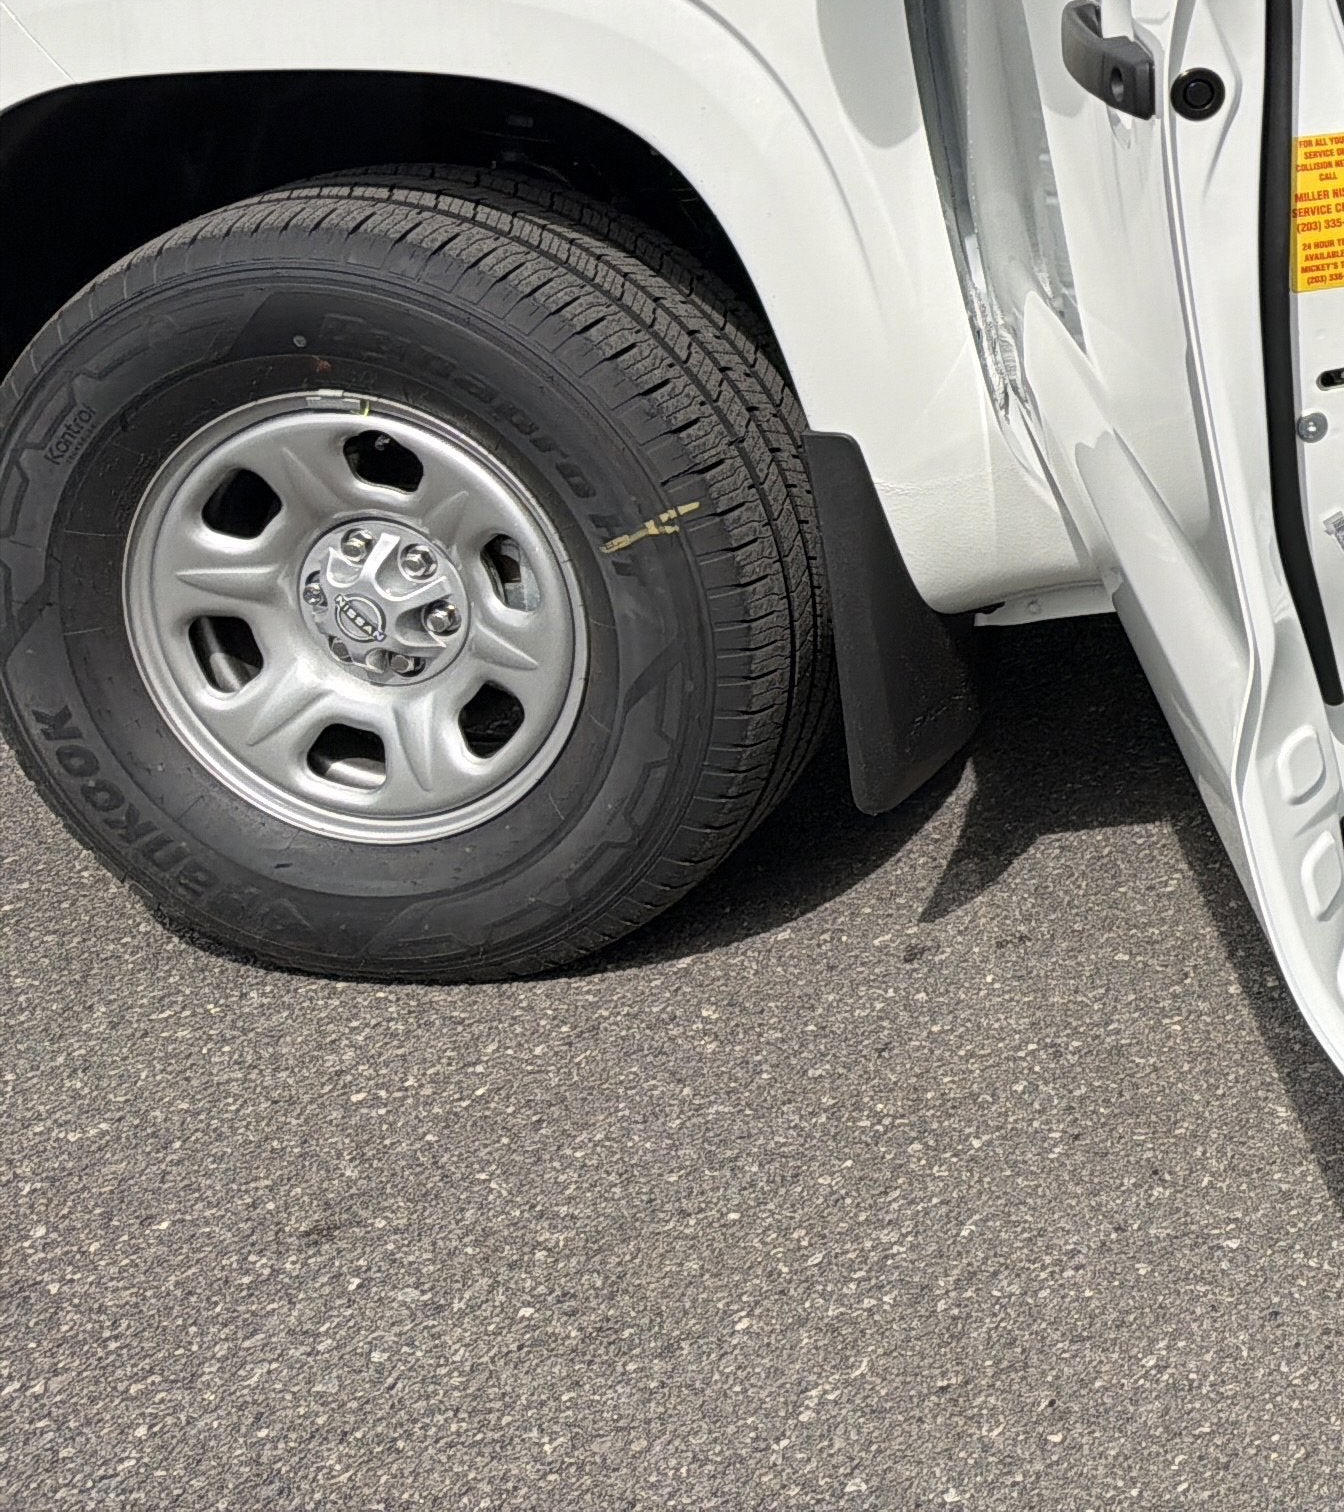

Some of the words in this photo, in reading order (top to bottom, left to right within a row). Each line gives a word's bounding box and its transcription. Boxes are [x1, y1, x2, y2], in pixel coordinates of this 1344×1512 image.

[1299, 139, 1313, 148] FOR
[1315, 137, 1328, 147] ALL
[1304, 148, 1334, 160] SERVICE
[1296, 160, 1334, 172] COLLISION
[1318, 172, 1338, 181] CALL
[1295, 190, 1330, 203] MILLER
[1292, 204, 1332, 219] SERVICE
[1297, 221, 1322, 234] (203)
[1302, 243, 1311, 251] 24
[1313, 239, 1335, 250] HOUR
[1304, 250, 1344, 262] AVAILABLE
[1300, 262, 1339, 274] MICKEY'S
[44, 402, 96, 466] Kontrol
[335, 594, 385, 642] NISSAN
